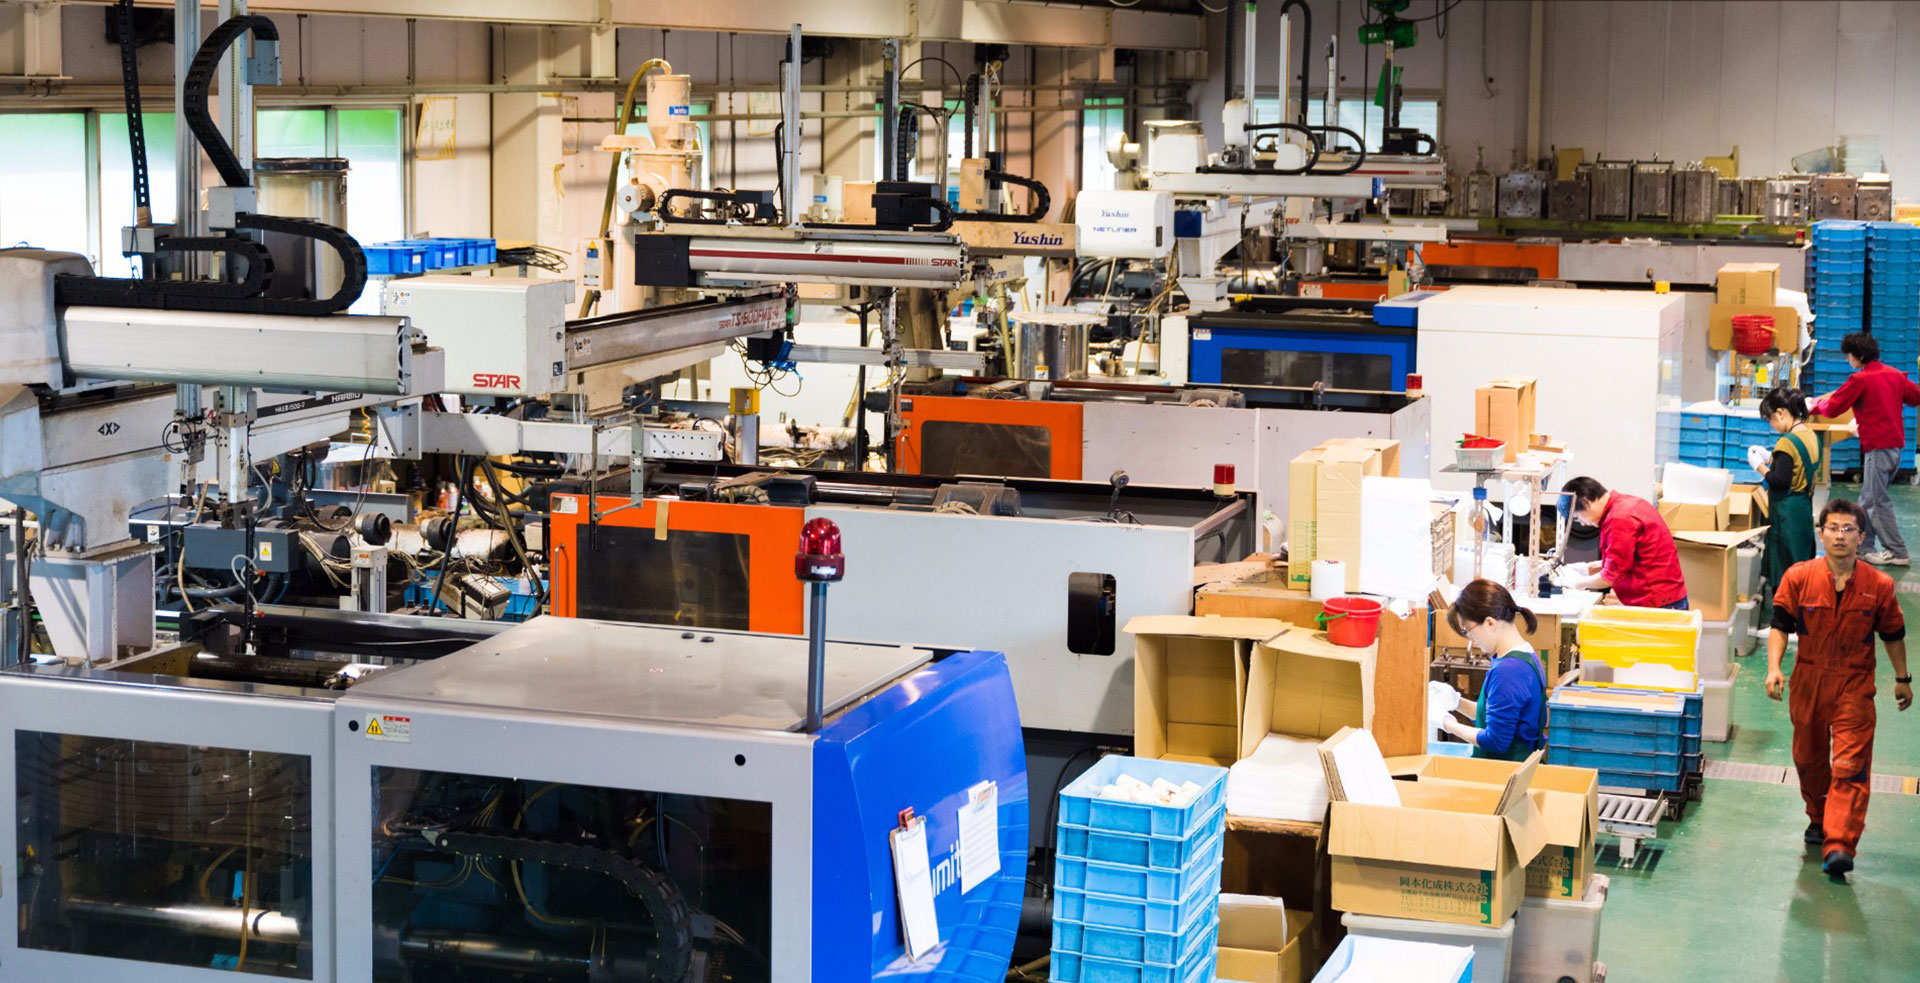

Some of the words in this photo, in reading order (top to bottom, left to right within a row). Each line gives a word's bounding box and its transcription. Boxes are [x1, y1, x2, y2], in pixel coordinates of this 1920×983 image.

[1101, 209, 1129, 218] Yushin
[1013, 231, 1064, 246] Yushin
[931, 258, 958, 267] STAR
[473, 373, 521, 390] STAR
[1400, 876, 1488, 895] 岡本化成株式会社
